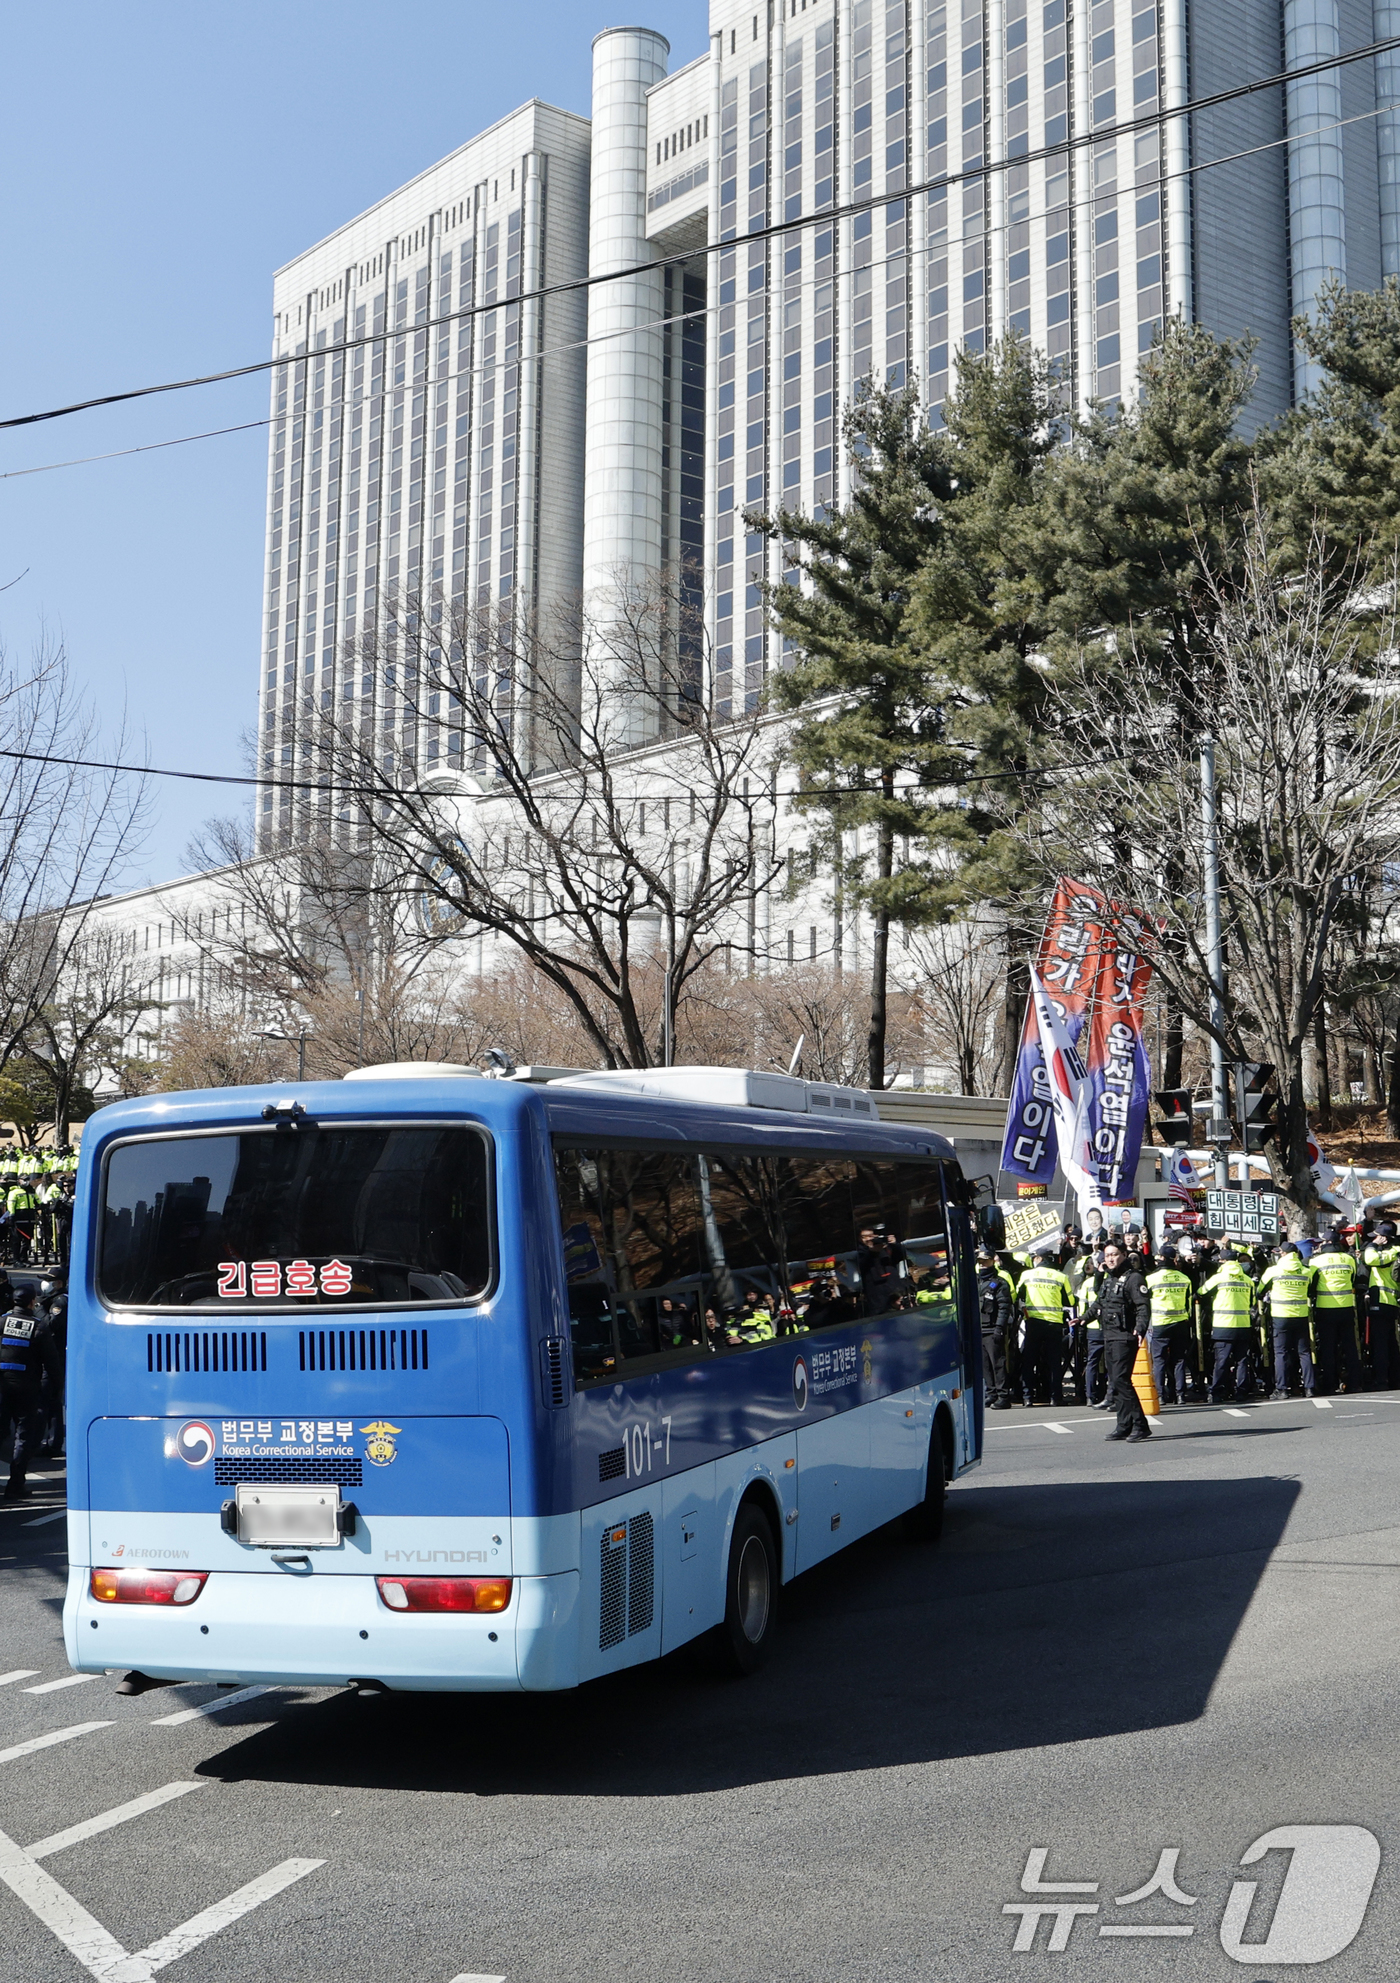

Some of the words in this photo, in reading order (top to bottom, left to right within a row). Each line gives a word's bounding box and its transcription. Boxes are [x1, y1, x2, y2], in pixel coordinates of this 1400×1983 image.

[1209, 1192, 1275, 1212] 대통령님
[1005, 1212, 1058, 1248] 정당했다
[1209, 1212, 1276, 1232] 힘내세요
[217, 1259, 353, 1297] 긴급호송
[812, 1351, 831, 1380] 법무부
[832, 1345, 857, 1373] 교정본부
[813, 1382, 825, 1395] Korea
[824, 1375, 845, 1392] Correctional
[844, 1371, 858, 1386] Service
[221, 1421, 273, 1443] 법무부
[280, 1421, 354, 1443] 교정본부
[222, 1444, 251, 1456] Korea
[252, 1444, 316, 1456] Correctional
[316, 1444, 354, 1456] Service
[622, 1415, 672, 1479] 101-7
[126, 1548, 190, 1559] AEROTOWN
[384, 1550, 488, 1563] HYUNDAI
